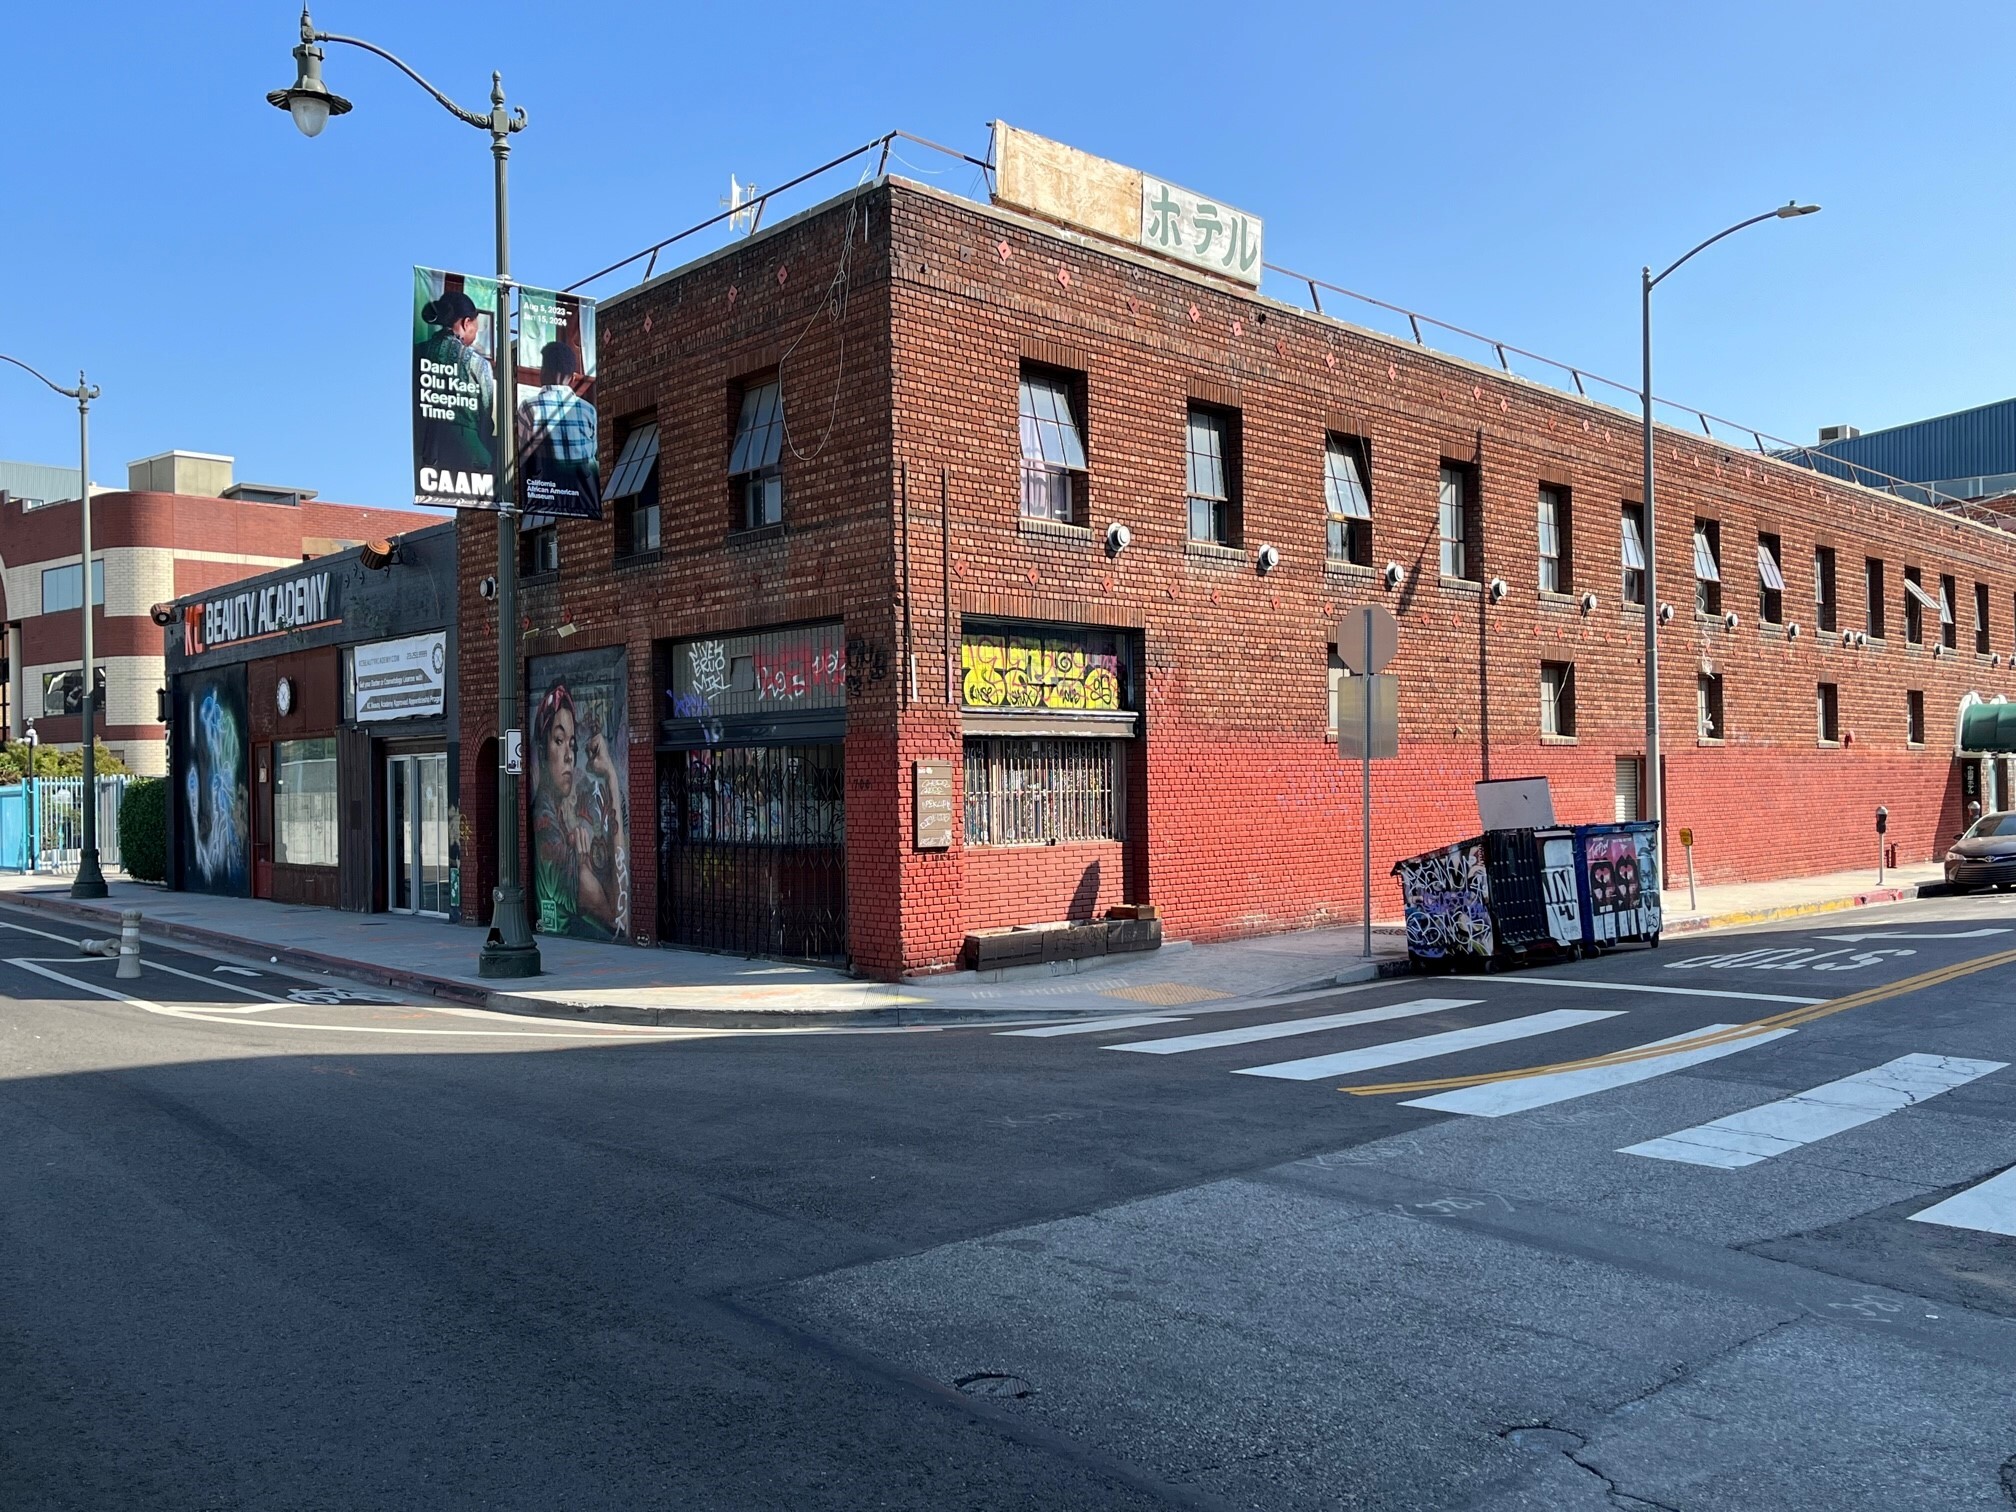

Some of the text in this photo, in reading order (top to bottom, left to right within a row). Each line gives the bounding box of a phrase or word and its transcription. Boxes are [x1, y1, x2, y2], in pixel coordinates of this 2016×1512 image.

[1147, 184, 1258, 273] ホテル
[523, 302, 539, 313] Aug
[540, 305, 547, 314] 5,
[548, 306, 566, 316] 2023
[538, 316, 548, 325] 15,
[549, 317, 567, 327] 2024
[420, 358, 458, 376] Darol
[420, 373, 480, 394] Olu Kae:
[420, 388, 478, 411] Keeping
[420, 403, 456, 420] Time
[419, 467, 494, 496] CAAM
[526, 478, 557, 488] California
[527, 485, 579, 496] African American
[527, 492, 555, 500] Museum
[184, 572, 330, 656] KC BEAUTY ACADEMY
[1663, 947, 1918, 972] STOP
